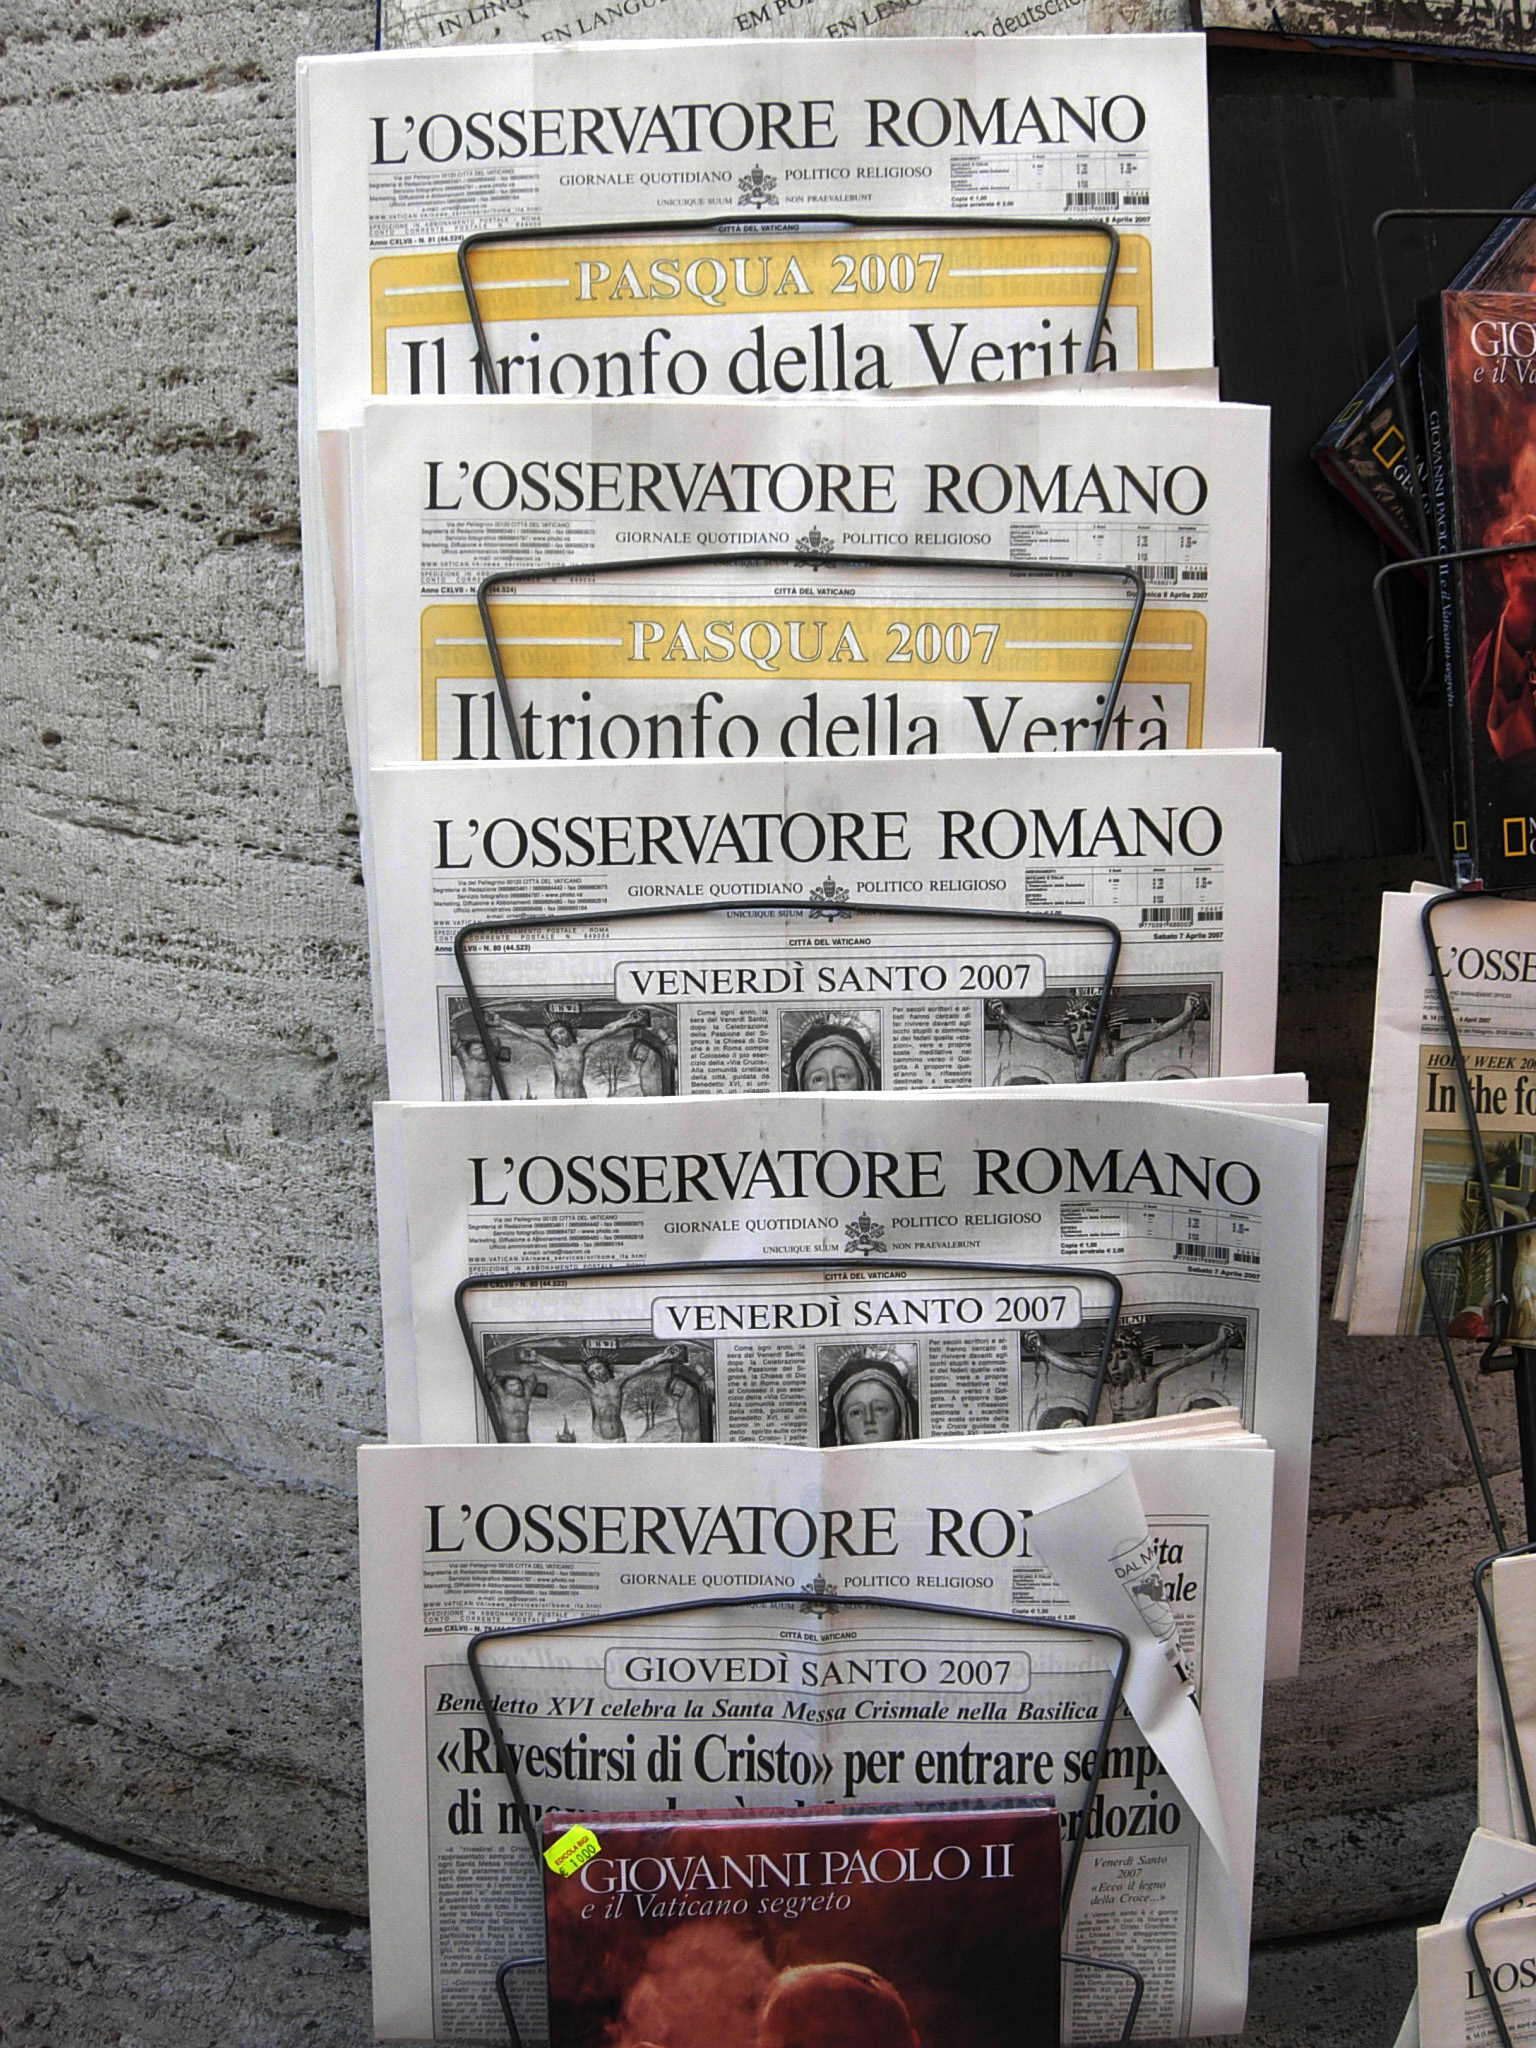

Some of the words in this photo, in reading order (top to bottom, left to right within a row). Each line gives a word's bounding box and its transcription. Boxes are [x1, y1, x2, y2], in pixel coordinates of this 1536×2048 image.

[437, 14, 463, 37] IN
[734, 5, 772, 31] EM
[826, 16, 857, 38] EN
[370, 101, 838, 166] L'OSSERVATORE
[865, 94, 1147, 148] ROMANO
[559, 173, 635, 186] GIORNALE
[640, 170, 732, 184] QUOTIDIANO
[785, 167, 850, 181] POLITICO
[856, 166, 933, 179] RELIGIOSO
[657, 197, 705, 207] UNICUIQUE
[707, 196, 733, 205] SUUM
[807, 193, 873, 203] PRAEVALEBUNT
[718, 223, 742, 233] CITTÀ
[743, 223, 759, 232] DEL
[761, 222, 800, 232] VATICANO
[1112, 216, 1133, 224] Aprile
[1134, 215, 1151, 223] 2007
[574, 255, 813, 307] PASQUA
[831, 252, 944, 296] 2007
[401, 337, 446, 395] Il
[728, 322, 893, 395] della
[1473, 367, 1484, 383] e
[1492, 357, 1507, 383] il
[1429, 410, 1445, 499] GIOVANNI
[424, 461, 897, 513] L'OSSERVATORE
[925, 462, 1208, 516] ROMANO
[615, 532, 691, 545] GIORNALE
[697, 531, 789, 545] QUOTIDIANO
[842, 532, 908, 545] POLITICO
[915, 533, 991, 546] RELIGIOSO
[774, 586, 797, 596] CITTÀ
[800, 587, 815, 596] DEL
[817, 587, 856, 596] VATICANO
[1170, 591, 1191, 599] Aprile
[1192, 591, 1208, 599] 2007
[628, 620, 867, 671] PASQUA
[886, 622, 1001, 664] 2007
[451, 691, 497, 760] Il
[520, 690, 759, 760] trionfo
[780, 692, 938, 758] della
[963, 694, 1167, 753] Verità
[433, 812, 911, 869] L'OSSERVATORE
[938, 806, 1223, 859] ROMANO
[628, 884, 703, 898] GIORNALE
[709, 881, 803, 897] QUOTIDIANO
[857, 880, 923, 893] POLITICO
[930, 878, 1006, 892] RELIGIOSO
[726, 910, 775, 919] UNICUIQUE
[778, 909, 803, 918] SUUM
[814, 939, 829, 947] DEL
[832, 938, 871, 947] VATICANO
[1185, 932, 1207, 940] Aprile
[630, 960, 803, 997] VENERDÌ
[817, 964, 947, 993] SANTO
[959, 964, 1031, 991] 2007
[1474, 1055, 1517, 1069] WEEK
[1425, 1072, 1456, 1113] In
[468, 1149, 946, 1206] L'OSSERVATORE
[973, 1147, 1261, 1206] ROMANO
[664, 1220, 740, 1234] GIORNALE
[746, 1217, 839, 1233] QUOTIDIANO
[891, 1216, 958, 1229] POLITICO
[965, 1212, 1042, 1226] RELIGIOSO
[763, 1245, 810, 1254] UNICUIQUE
[814, 1244, 839, 1252] SUUM
[892, 1242, 911, 1251] NON
[914, 1240, 981, 1250] PRAEVALEBUNT
[825, 1271, 848, 1280] CITTÀ
[849, 1272, 865, 1281] DEL
[867, 1271, 907, 1281] VATICANO
[1188, 1266, 1213, 1275] Sabato
[1220, 1269, 1242, 1279] Aprile
[1244, 1271, 1261, 1280] 2007
[667, 1296, 839, 1331] VENERDÌ
[854, 1297, 984, 1326] SANTO
[995, 1296, 1067, 1323] 2007
[425, 1503, 899, 1559] L'OSSERVATORE
[1114, 1561, 1142, 1579] DAL
[620, 1574, 696, 1587] GIORNALE
[702, 1575, 795, 1588] QUOTIDIANO
[844, 1575, 910, 1588] POLITICO
[916, 1575, 994, 1589] RELIGIOSO
[780, 1631, 802, 1641] CITTÀ
[804, 1632, 819, 1641] DEL
[820, 1631, 857, 1641] VATICANO
[625, 1652, 790, 1684] GIOVEDÌ
[802, 1657, 927, 1687] SANTO
[940, 1659, 1011, 1687] 2007
[547, 1697, 592, 1717] XVI
[600, 1697, 676, 1719] celebra
[684, 1698, 702, 1719] la
[712, 1699, 774, 1719] Santa
[783, 1700, 846, 1723] Messa
[855, 1699, 949, 1721] Crismale
[957, 1700, 1007, 1721] nella
[1016, 1701, 1099, 1721] Basilica
[647, 1734, 682, 1783] di
[694, 1733, 834, 1787] Cristo»
[843, 1750, 904, 1798] per
[915, 1742, 1054, 1786] entrare
[447, 1788, 483, 1835] di
[580, 1851, 810, 1895] GIOVANNI
[820, 1845, 971, 1885] PAOLO
[981, 1844, 1015, 1878] II
[1094, 1856, 1134, 1868] Venerdì
[1138, 1855, 1168, 1866] Santo
[1117, 1868, 1143, 1879] 2007
[1138, 1880, 1167, 1892] legno
[581, 1904, 593, 1920] e
[604, 1892, 623, 1920] il
[633, 1893, 748, 1920] Vaticano
[758, 1892, 851, 1920] segreto
[1090, 1894, 1115, 1906] della
